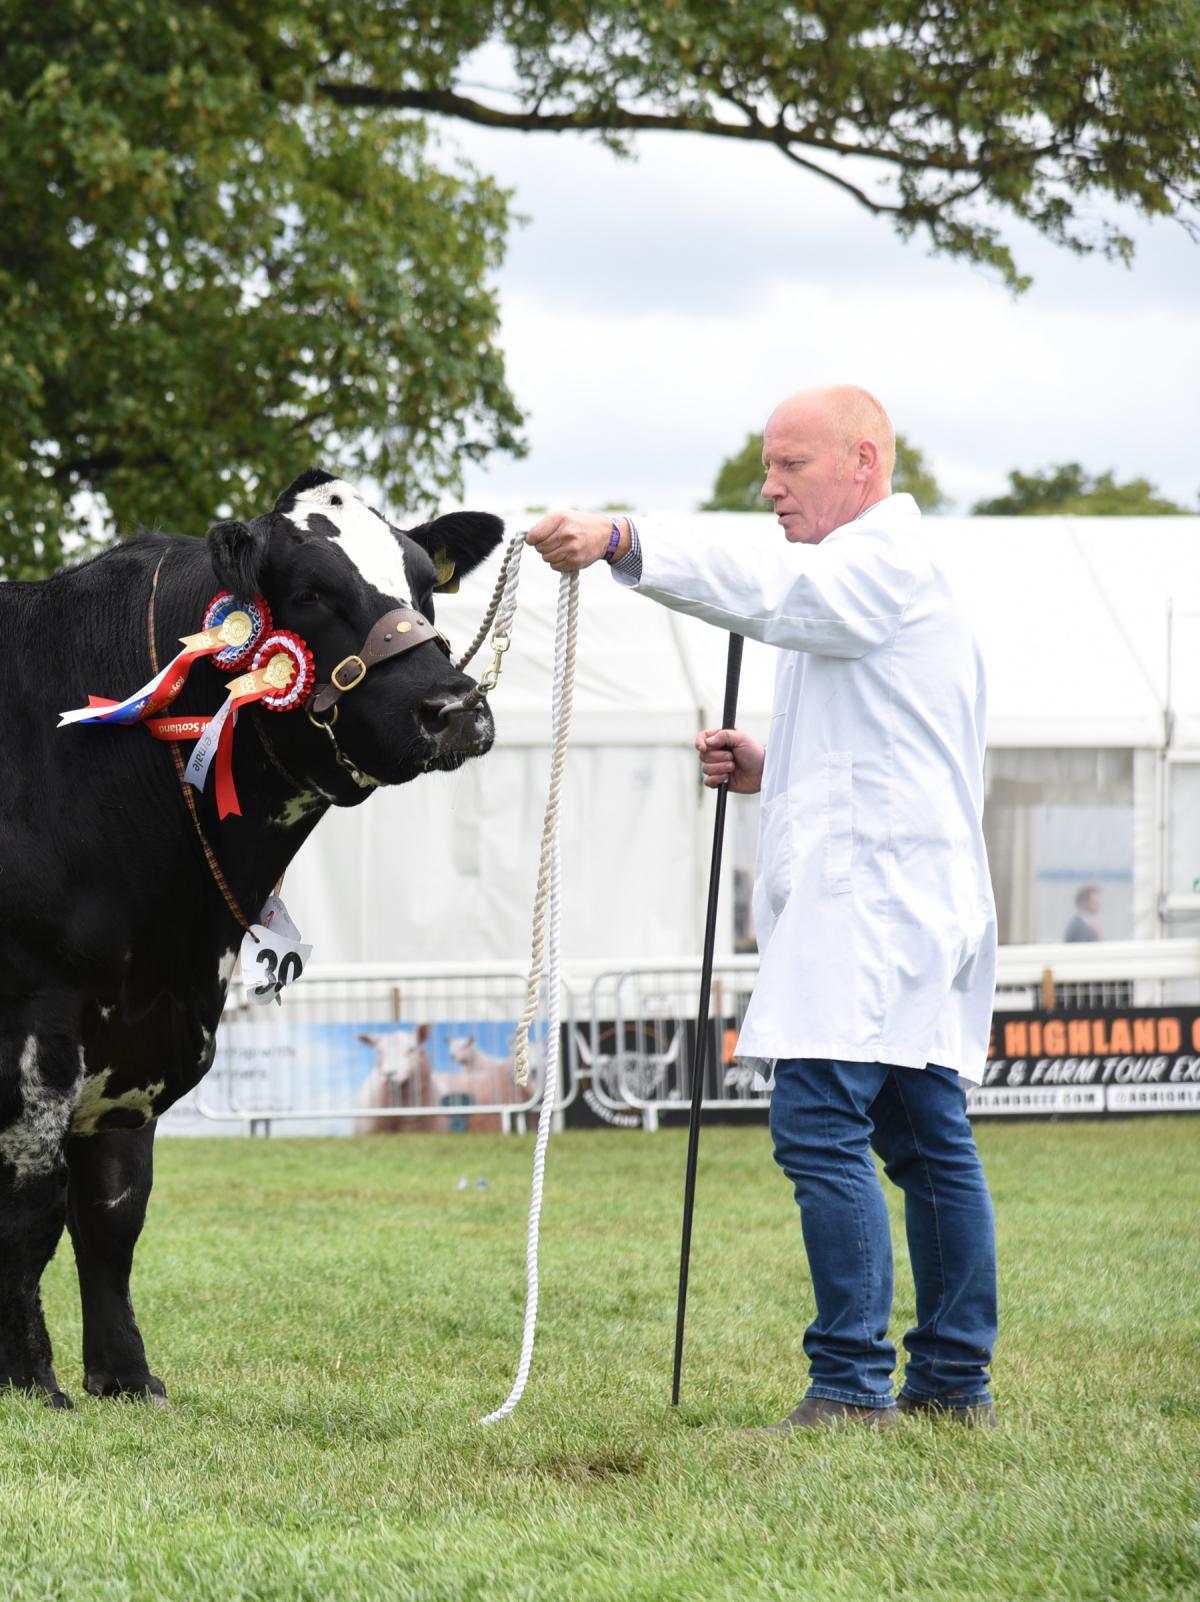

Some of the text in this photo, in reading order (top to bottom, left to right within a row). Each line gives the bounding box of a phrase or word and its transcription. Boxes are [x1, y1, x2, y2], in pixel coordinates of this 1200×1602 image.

[158, 721, 200, 734] Scotland
[255, 948, 303, 996] 30
[1004, 1016, 1182, 1058] HIGHLAND
[1007, 1059, 1027, 1087] &
[1030, 1057, 1100, 1086] FARM
[1101, 1055, 1169, 1084] TOUR
